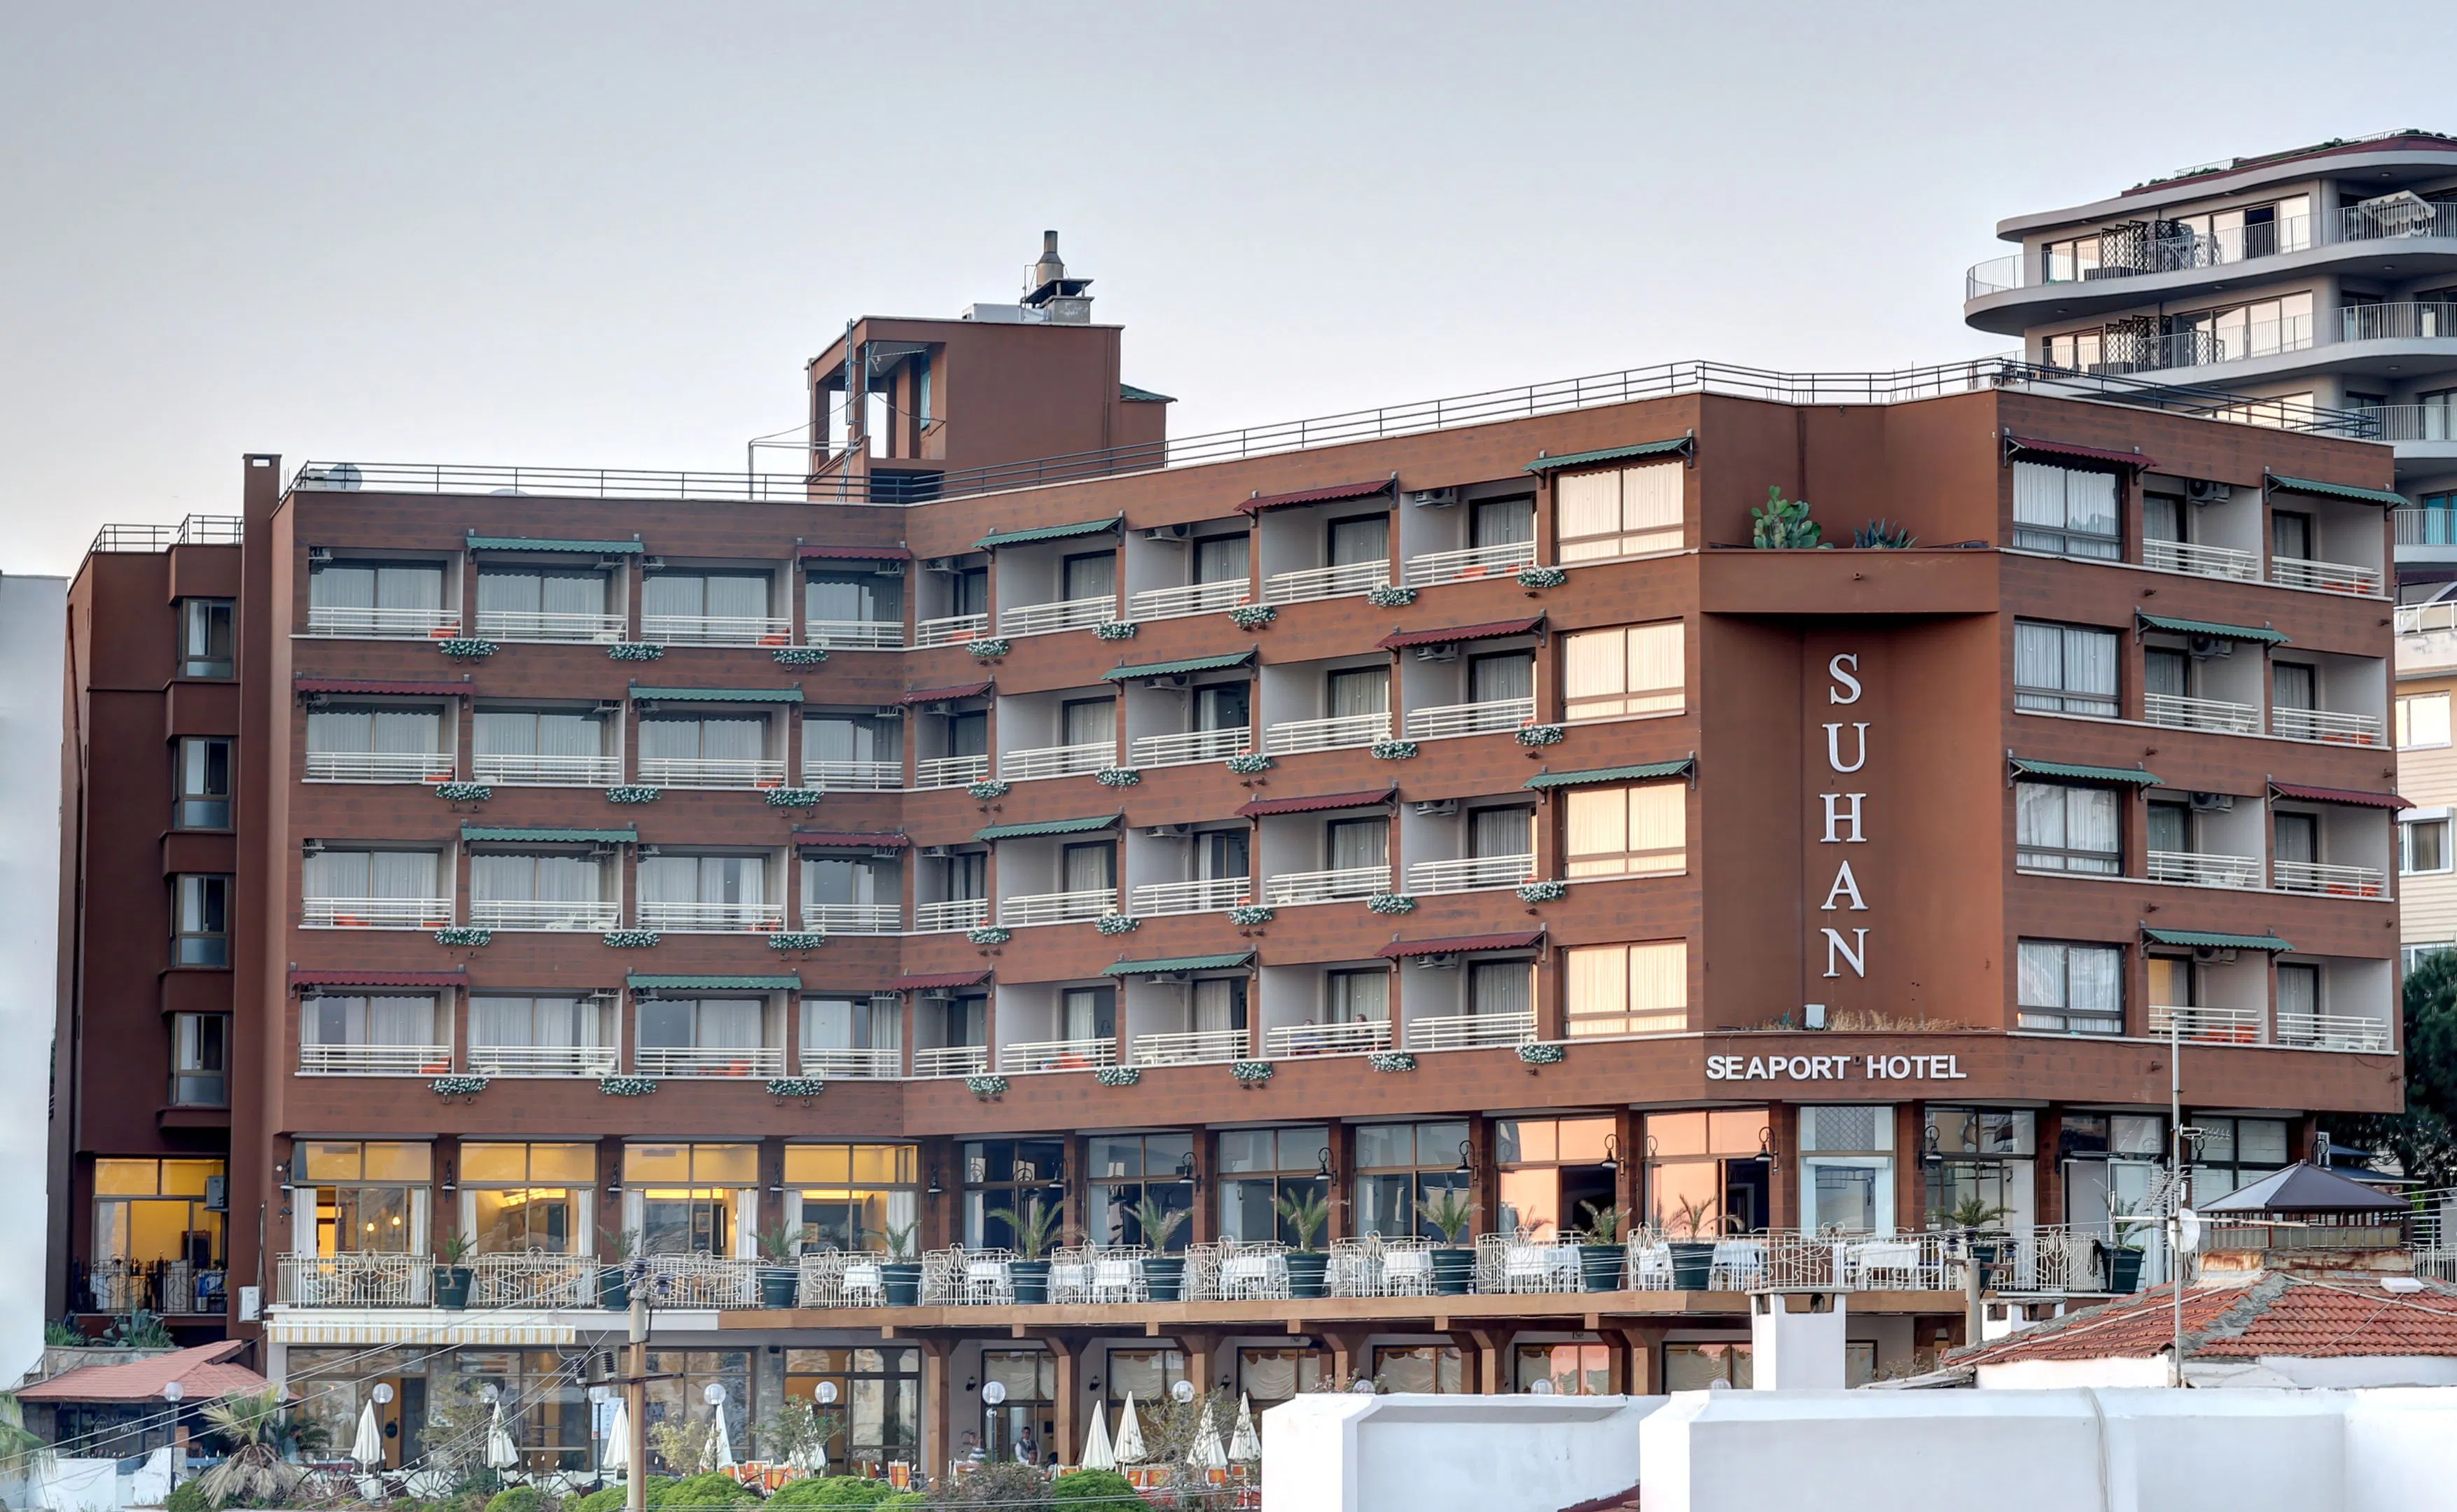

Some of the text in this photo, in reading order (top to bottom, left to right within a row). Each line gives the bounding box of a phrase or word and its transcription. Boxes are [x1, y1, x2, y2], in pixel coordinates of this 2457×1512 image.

[1819, 652, 1870, 978] SUHAN
[1706, 1055, 1967, 1080] SEAPORT HOTEL
